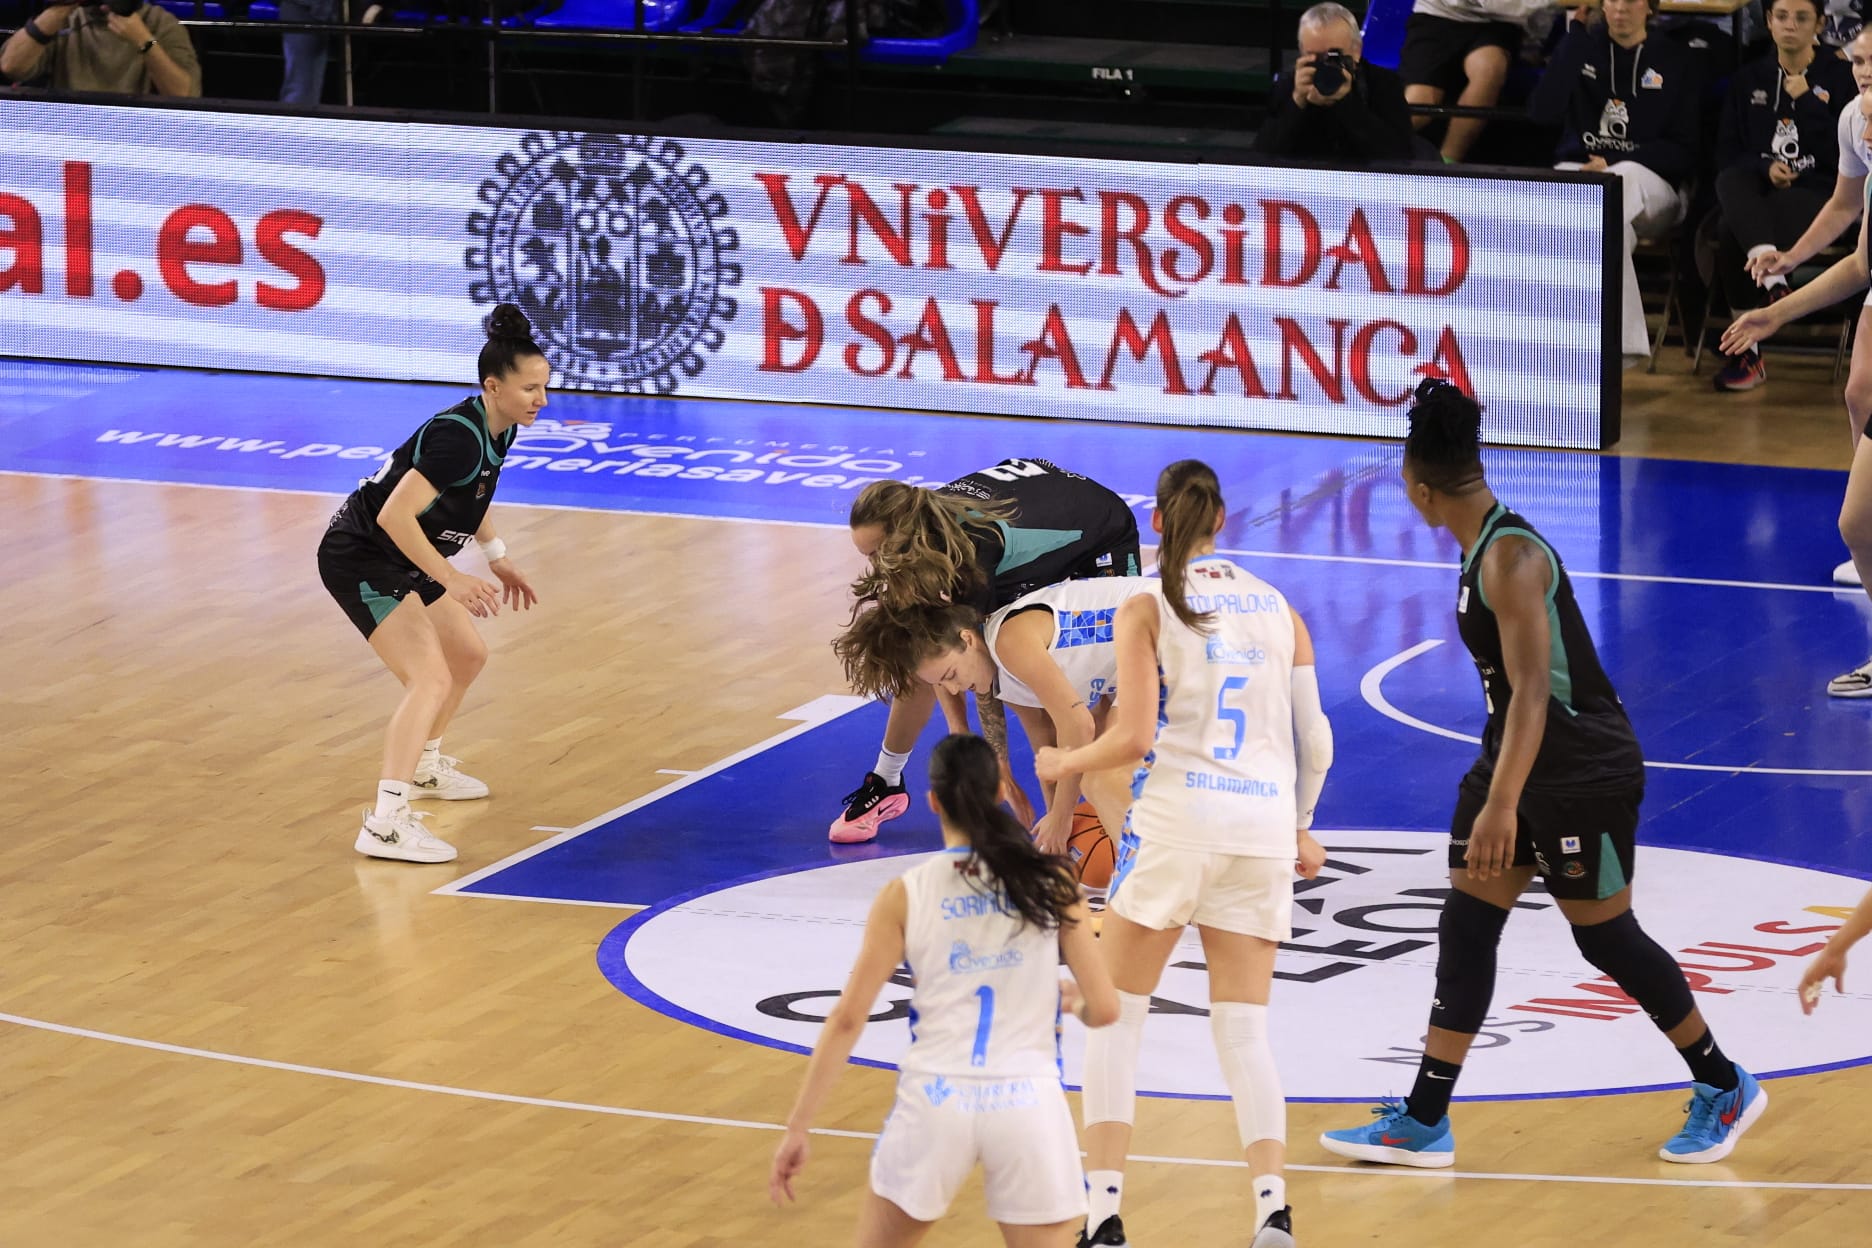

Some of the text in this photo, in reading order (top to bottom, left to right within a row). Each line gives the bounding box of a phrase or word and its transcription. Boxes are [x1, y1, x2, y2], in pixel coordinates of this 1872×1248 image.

[1092, 67, 1123, 80] FILA
[843, 287, 1484, 411] SALAMANCA
[1213, 676, 1249, 760] 5
[1185, 771, 1279, 797] SALAMANCA
[974, 984, 995, 1067] 1
